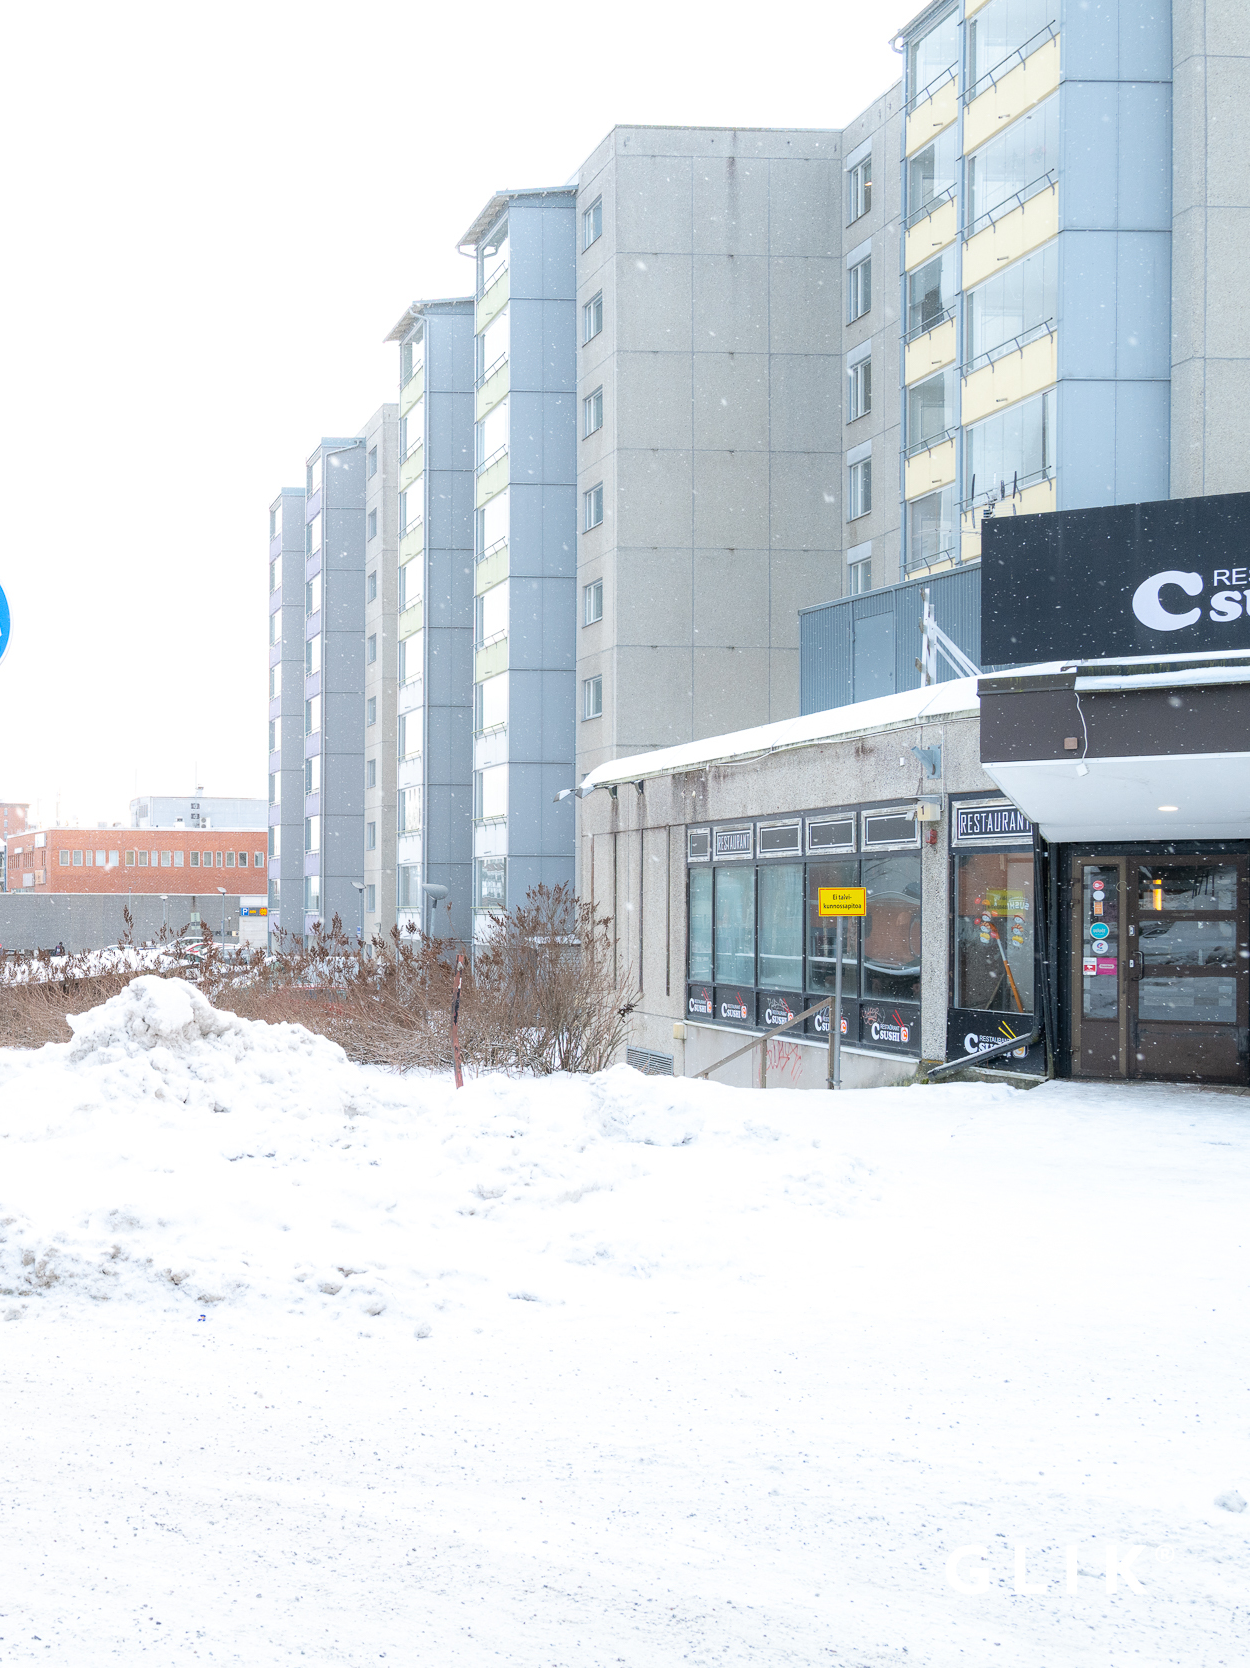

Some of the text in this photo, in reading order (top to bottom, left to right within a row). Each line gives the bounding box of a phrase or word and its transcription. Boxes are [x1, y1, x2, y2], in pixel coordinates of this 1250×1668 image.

[1213, 567, 1250, 587] RE
[1209, 590, 1250, 622] S
[718, 834, 749, 850] RESTAURANT
[726, 1009, 741, 1018] SUSHI
[880, 1030, 900, 1042] SUSHI
